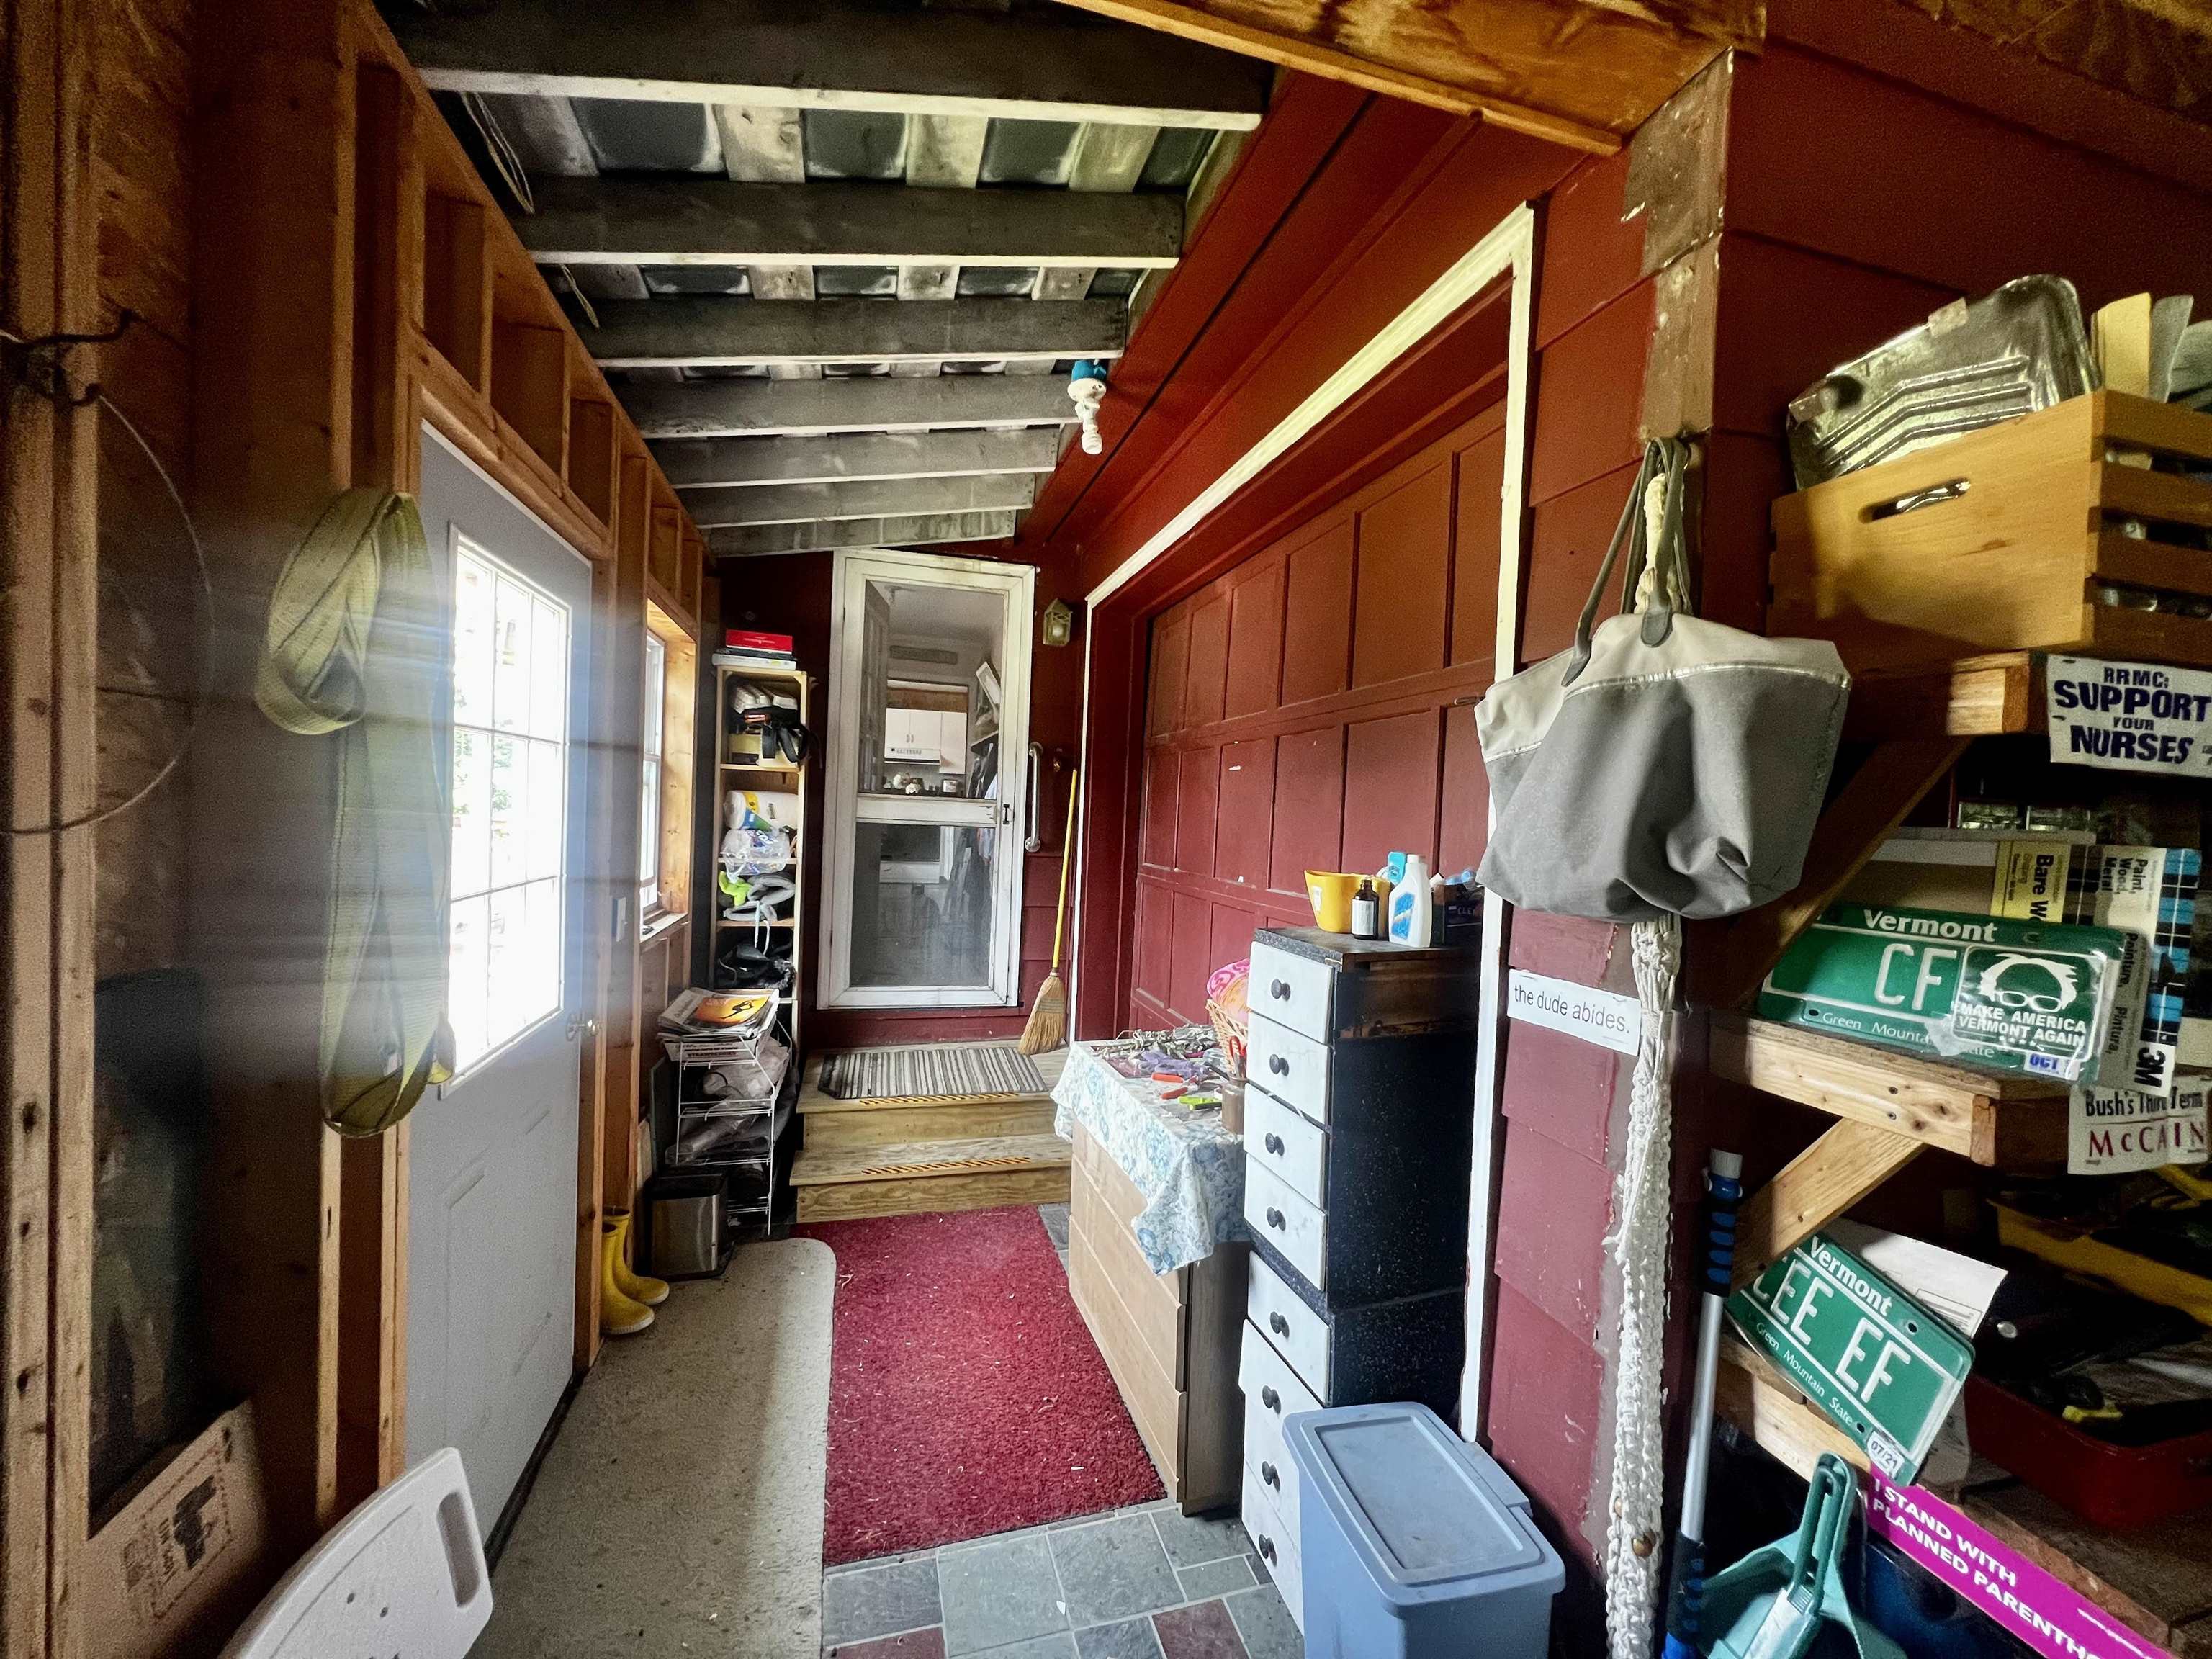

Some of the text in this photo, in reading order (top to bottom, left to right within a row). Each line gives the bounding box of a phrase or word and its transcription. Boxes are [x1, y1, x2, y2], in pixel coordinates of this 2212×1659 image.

[2104, 667, 2170, 689] RRMC:
[2054, 679, 2212, 722] SUPPORT
[2113, 717, 2154, 731] YOUR
[2070, 724, 2194, 765] NURSES
[2032, 854, 2054, 895] Bare
[2101, 856, 2118, 891] Metal
[2117, 858, 2134, 895] Wood,
[2128, 858, 2149, 894] Paint,
[1863, 909, 1998, 943] Vermont
[1874, 943, 1958, 1012] CF
[1514, 984, 1630, 1034] the dude abides.
[1822, 1012, 1862, 1030] Green
[1957, 1002, 2087, 1034] MAKE AMERICA
[1959, 1015, 2085, 1048] VERMONT AGAIN
[2105, 1006, 2128, 1055] Pintura,
[2029, 1053, 2059, 1071] OCT
[2134, 1046, 2167, 1088] 3M
[2085, 1090, 2135, 1117] Bush's
[2089, 1120, 2206, 1159] McCAIN
[1810, 1235, 1894, 1317] Vermont
[1757, 1322, 1853, 1425] Green Mountain State
[1835, 1317, 1912, 1403] EF
[1871, 1440, 1899, 1470] 07/21
[1873, 1499, 1970, 1575] PLANNED
[1874, 1478, 2017, 1588] I STAND WITH
